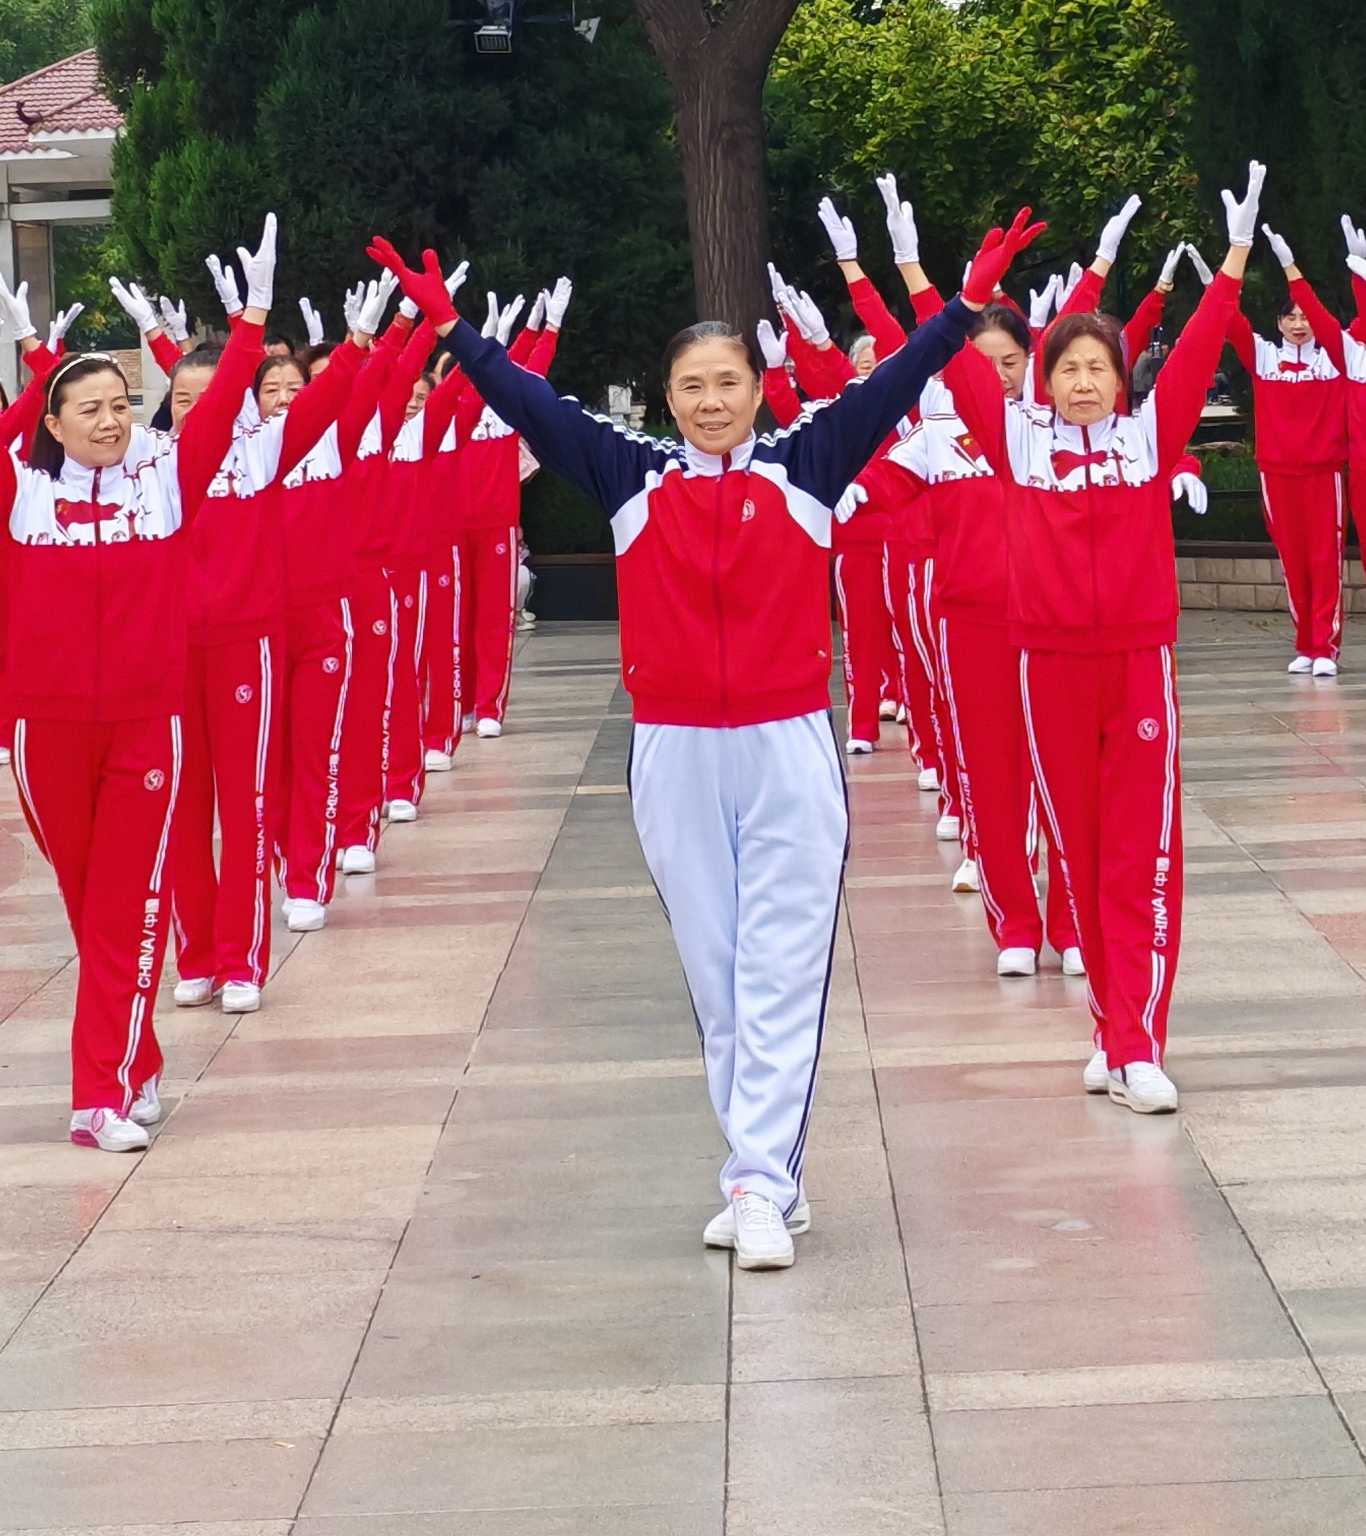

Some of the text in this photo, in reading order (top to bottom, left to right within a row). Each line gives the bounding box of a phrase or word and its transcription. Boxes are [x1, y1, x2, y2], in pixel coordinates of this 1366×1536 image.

[453, 647, 461, 698] CHNA/
[381, 710, 390, 770] CHNA/中
[255, 796, 264, 874] CHINA/中
[960, 772, 978, 847] CINA/
